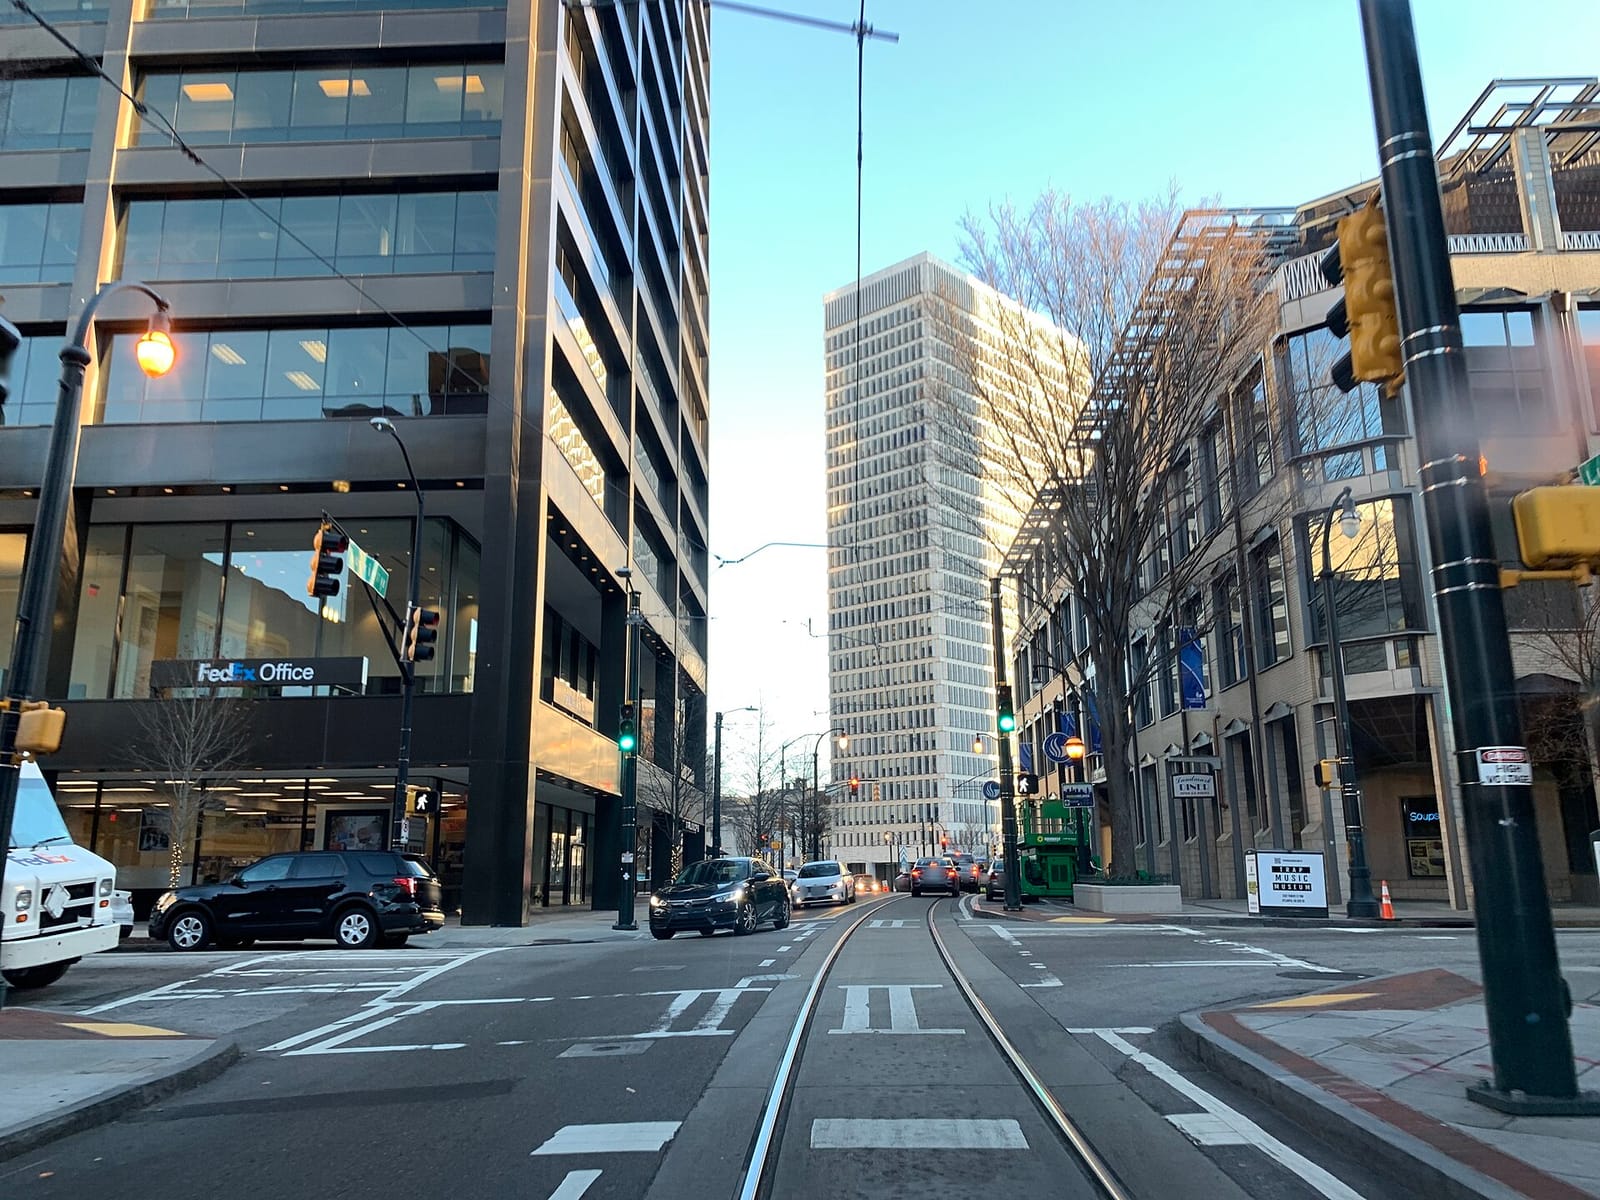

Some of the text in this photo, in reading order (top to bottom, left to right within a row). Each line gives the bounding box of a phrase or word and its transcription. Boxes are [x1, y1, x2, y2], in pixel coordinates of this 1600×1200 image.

[197, 661, 315, 682] FedEx Office
[1409, 811, 1440, 822] Soups
[7, 852, 76, 867] FedEx
[1275, 874, 1309, 882] MUSIC
[1273, 883, 1311, 891] MUSEUM
